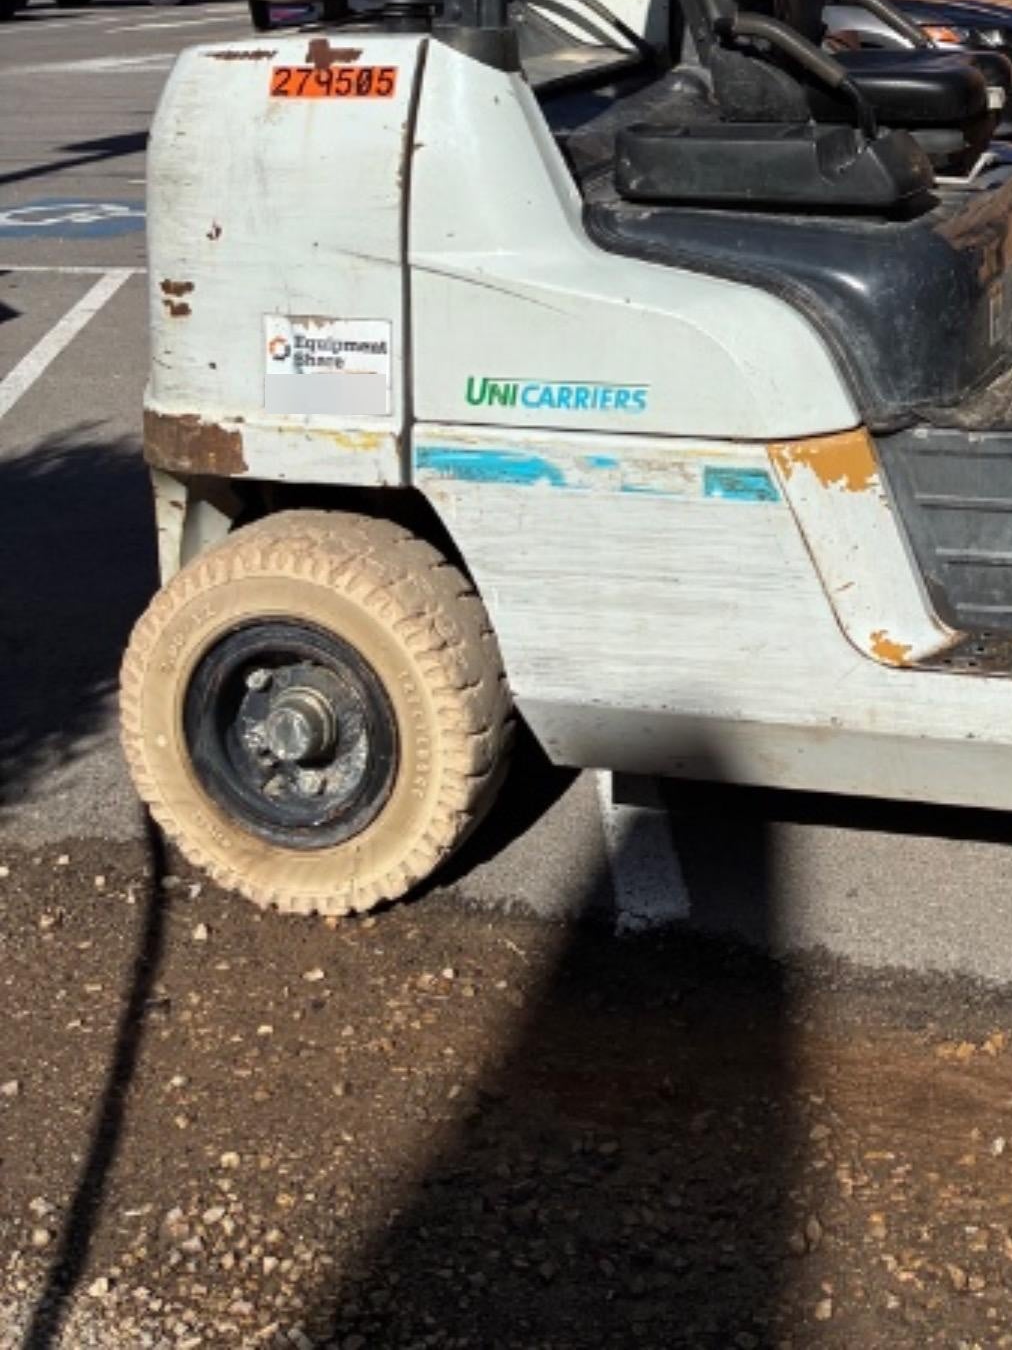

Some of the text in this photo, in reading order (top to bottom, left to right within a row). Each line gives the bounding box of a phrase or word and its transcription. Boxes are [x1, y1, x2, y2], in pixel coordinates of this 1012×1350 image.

[271, 67, 395, 97] 279505
[293, 335, 388, 355] Equipment
[465, 376, 650, 411] UNICARRIERS
